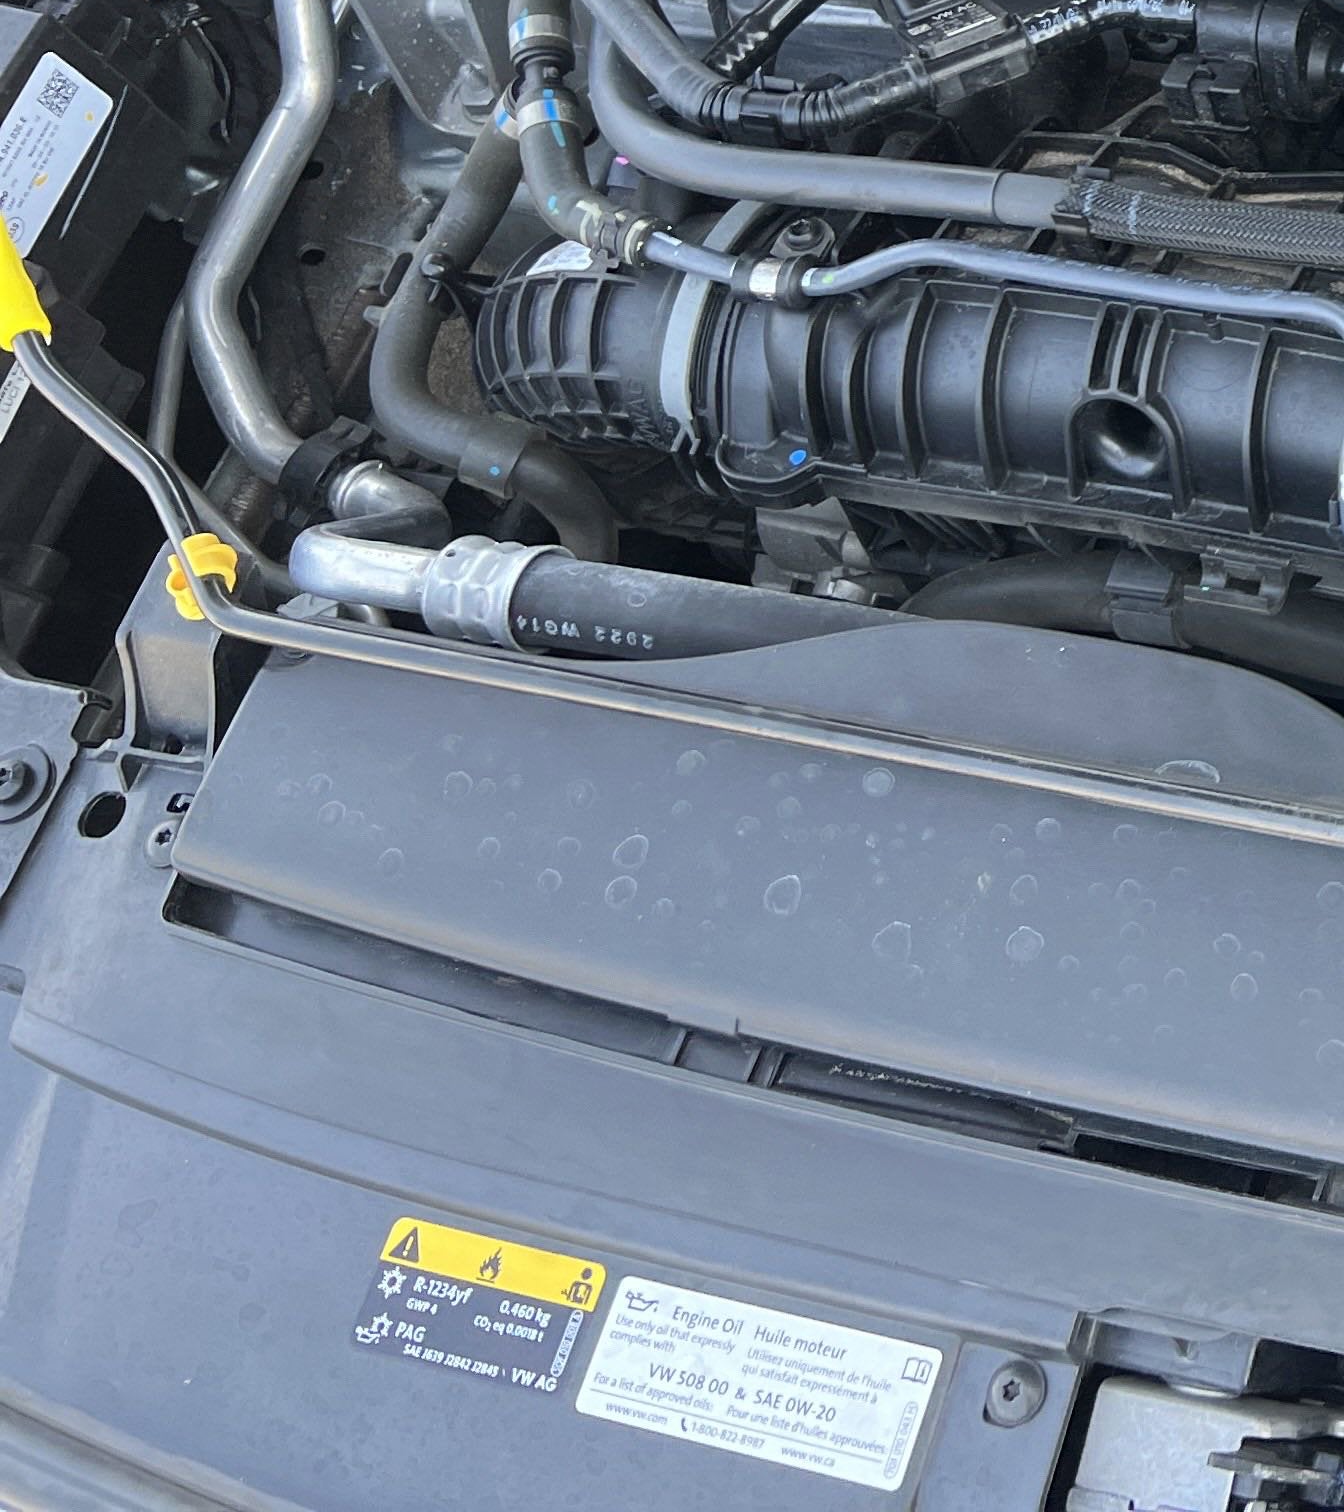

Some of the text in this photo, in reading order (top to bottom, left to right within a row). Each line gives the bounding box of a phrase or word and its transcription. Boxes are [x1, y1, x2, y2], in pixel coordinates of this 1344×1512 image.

[405, 1297, 431, 1313] GWP
[411, 1274, 473, 1309] R-1234yf
[497, 1298, 552, 1328] 0.460 kg
[670, 1305, 744, 1335] Engine Oil
[394, 1321, 426, 1343] PAG
[491, 1320, 506, 1335] eq
[608, 1328, 675, 1353] complies with
[615, 1314, 736, 1355] Use only oil that expressly
[402, 1342, 422, 1358] SAE
[753, 1324, 847, 1361] Huile moteur
[746, 1346, 784, 1366] Utilisez
[782, 1357, 845, 1383] uniquement
[844, 1371, 860, 1384] de
[509, 1367, 558, 1392] VW AG
[593, 1372, 610, 1386] For
[617, 1378, 634, 1392] list
[633, 1381, 647, 1395] of
[644, 1385, 692, 1408] approved
[647, 1363, 837, 1422] VW 508 00 & SAE 0W-20
[740, 1361, 759, 1376] qui
[758, 1366, 799, 1385] satisfait
[869, 1393, 879, 1405] à
[604, 1401, 668, 1426] www.vw.com
[726, 1406, 748, 1420] Pour
[748, 1412, 765, 1424] une
[765, 1415, 789, 1431] liste
[780, 1444, 836, 1467] www.vw.ca
